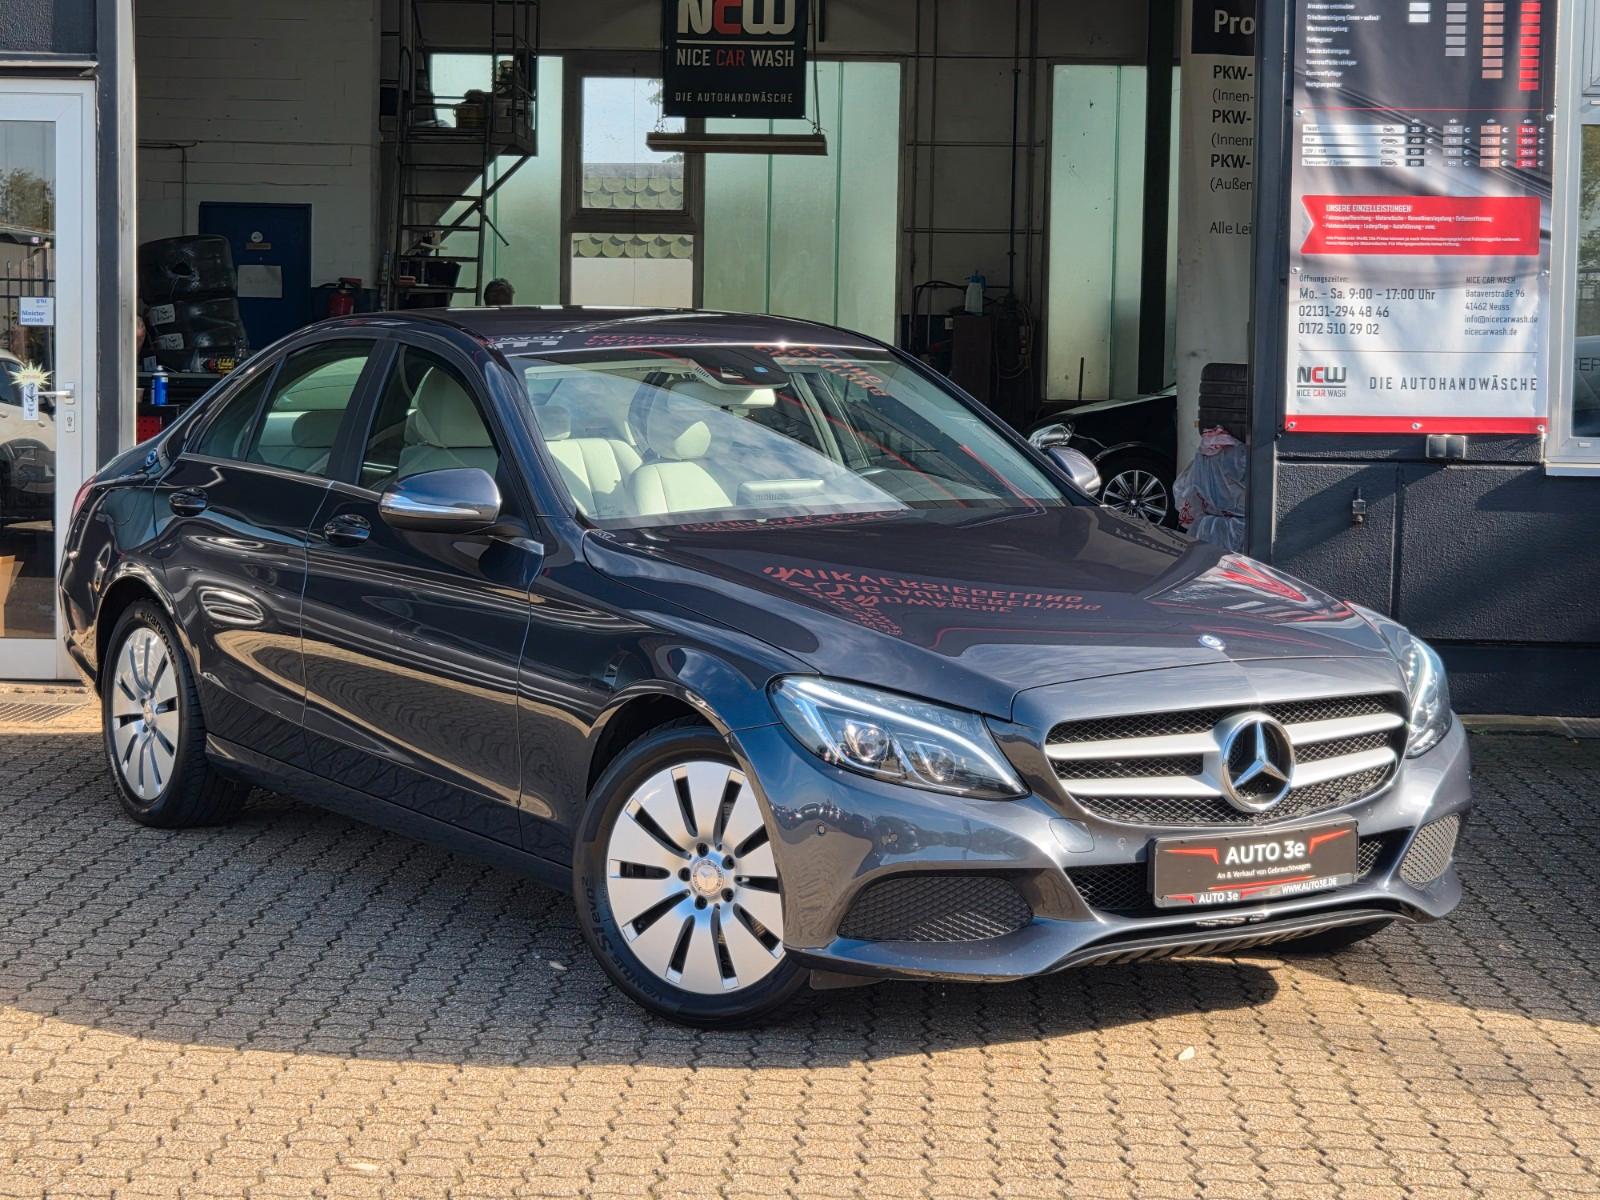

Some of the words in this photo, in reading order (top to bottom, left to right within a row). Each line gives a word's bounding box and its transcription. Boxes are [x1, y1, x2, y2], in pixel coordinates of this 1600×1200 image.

[1214, 9, 1255, 34] Pro
[676, 48, 710, 67] NICE
[716, 49, 745, 67] CAR
[750, 49, 795, 67] WASH
[1213, 65, 1253, 81] PKW-
[675, 92, 692, 102] DIE
[697, 91, 793, 103] AUTOHANDWÄSCHE
[1212, 88, 1254, 104] (Innen-
[1212, 109, 1252, 125] PKW-
[1211, 154, 1251, 168] PKW-
[1209, 221, 1233, 234] Alle
[1466, 276, 1481, 284] NICE
[1482, 276, 1495, 284] CAR
[1497, 276, 1516, 284] WASH
[1299, 288, 1318, 299] Mo.
[1330, 288, 1345, 299] Sa.
[1349, 288, 1373, 299] 9:00
[1385, 288, 1415, 300] 17:00
[1418, 289, 1435, 300] Uhr
[1515, 289, 1525, 297] 96
[1299, 306, 1355, 317] 02131-294
[1359, 306, 1372, 317] 48
[1375, 306, 1389, 318] 46
[1465, 302, 1487, 310] 41462
[1489, 303, 1510, 311] Neuss
[1464, 315, 1538, 324] info@nicecarwash.de
[1298, 322, 1323, 334] 0172
[1327, 323, 1346, 334] 510
[1349, 323, 1363, 334] 29
[1366, 323, 1379, 335] 02
[1369, 376, 1393, 390] DIE
[1400, 375, 1537, 391] AUTOHANDWÄSCHE
[1296, 389, 1311, 397] NICE
[1313, 389, 1325, 397] CAR
[1327, 389, 1347, 397] WASH
[1224, 843, 1281, 865] AUTO
[1283, 840, 1306, 859] 3e
[1233, 868, 1255, 878] Verkauf
[1198, 891, 1226, 904] AUTO
[1227, 891, 1239, 902] 3e
